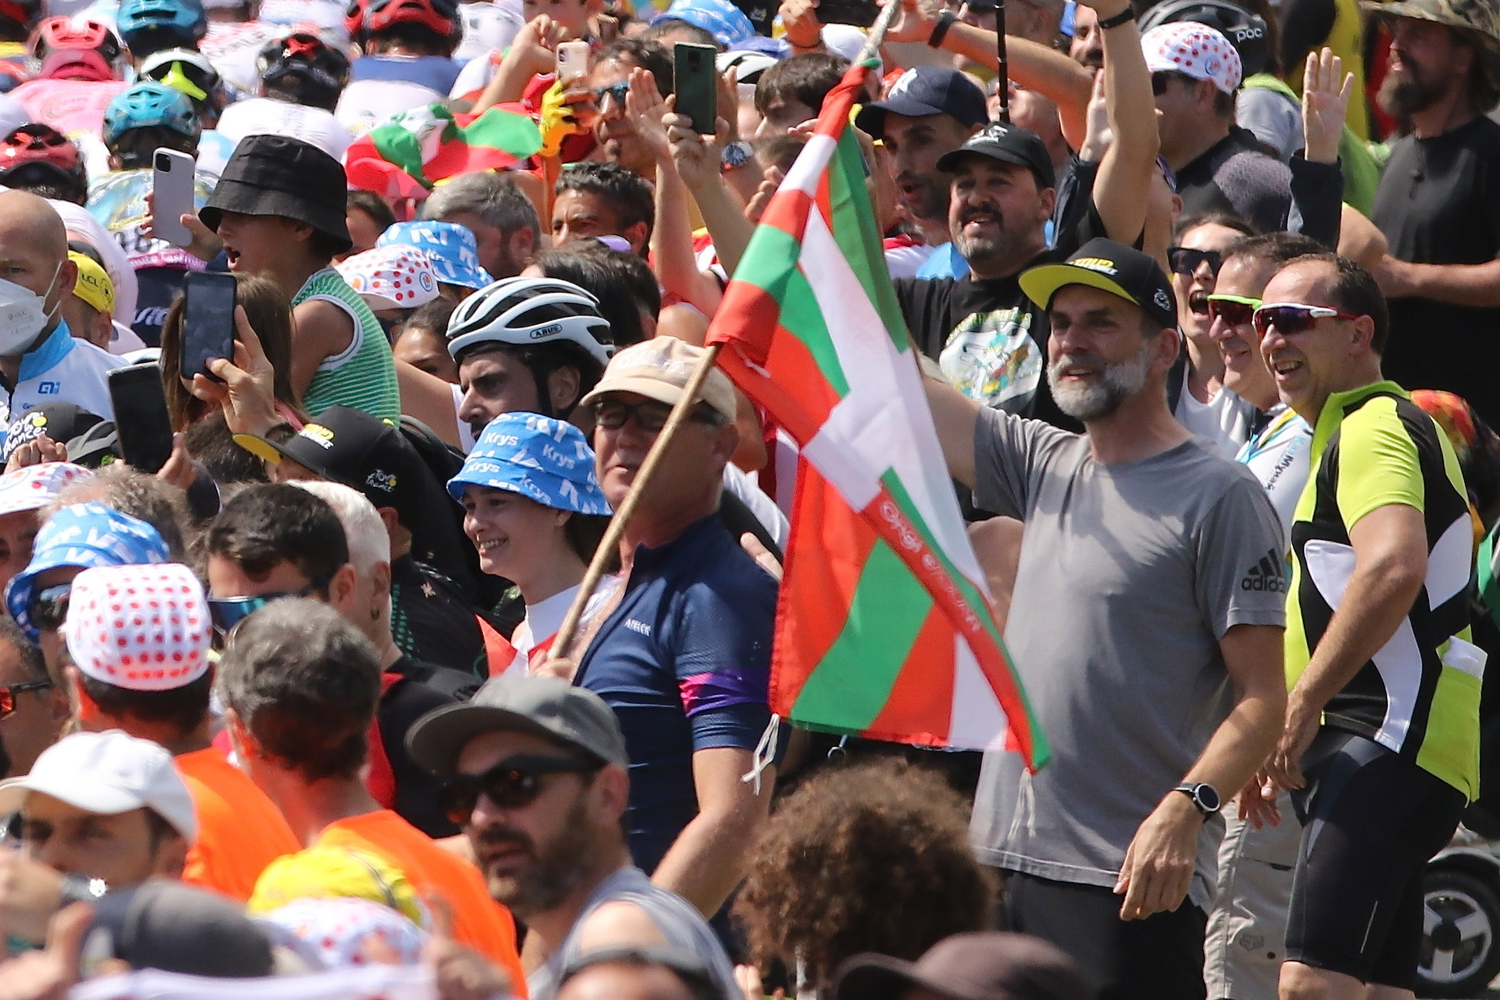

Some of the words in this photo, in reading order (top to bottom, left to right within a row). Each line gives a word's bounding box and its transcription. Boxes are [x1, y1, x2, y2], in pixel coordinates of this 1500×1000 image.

[534, 325, 559, 337] ABUS
[484, 432, 520, 447] Krys
[543, 444, 575, 470] Krys
